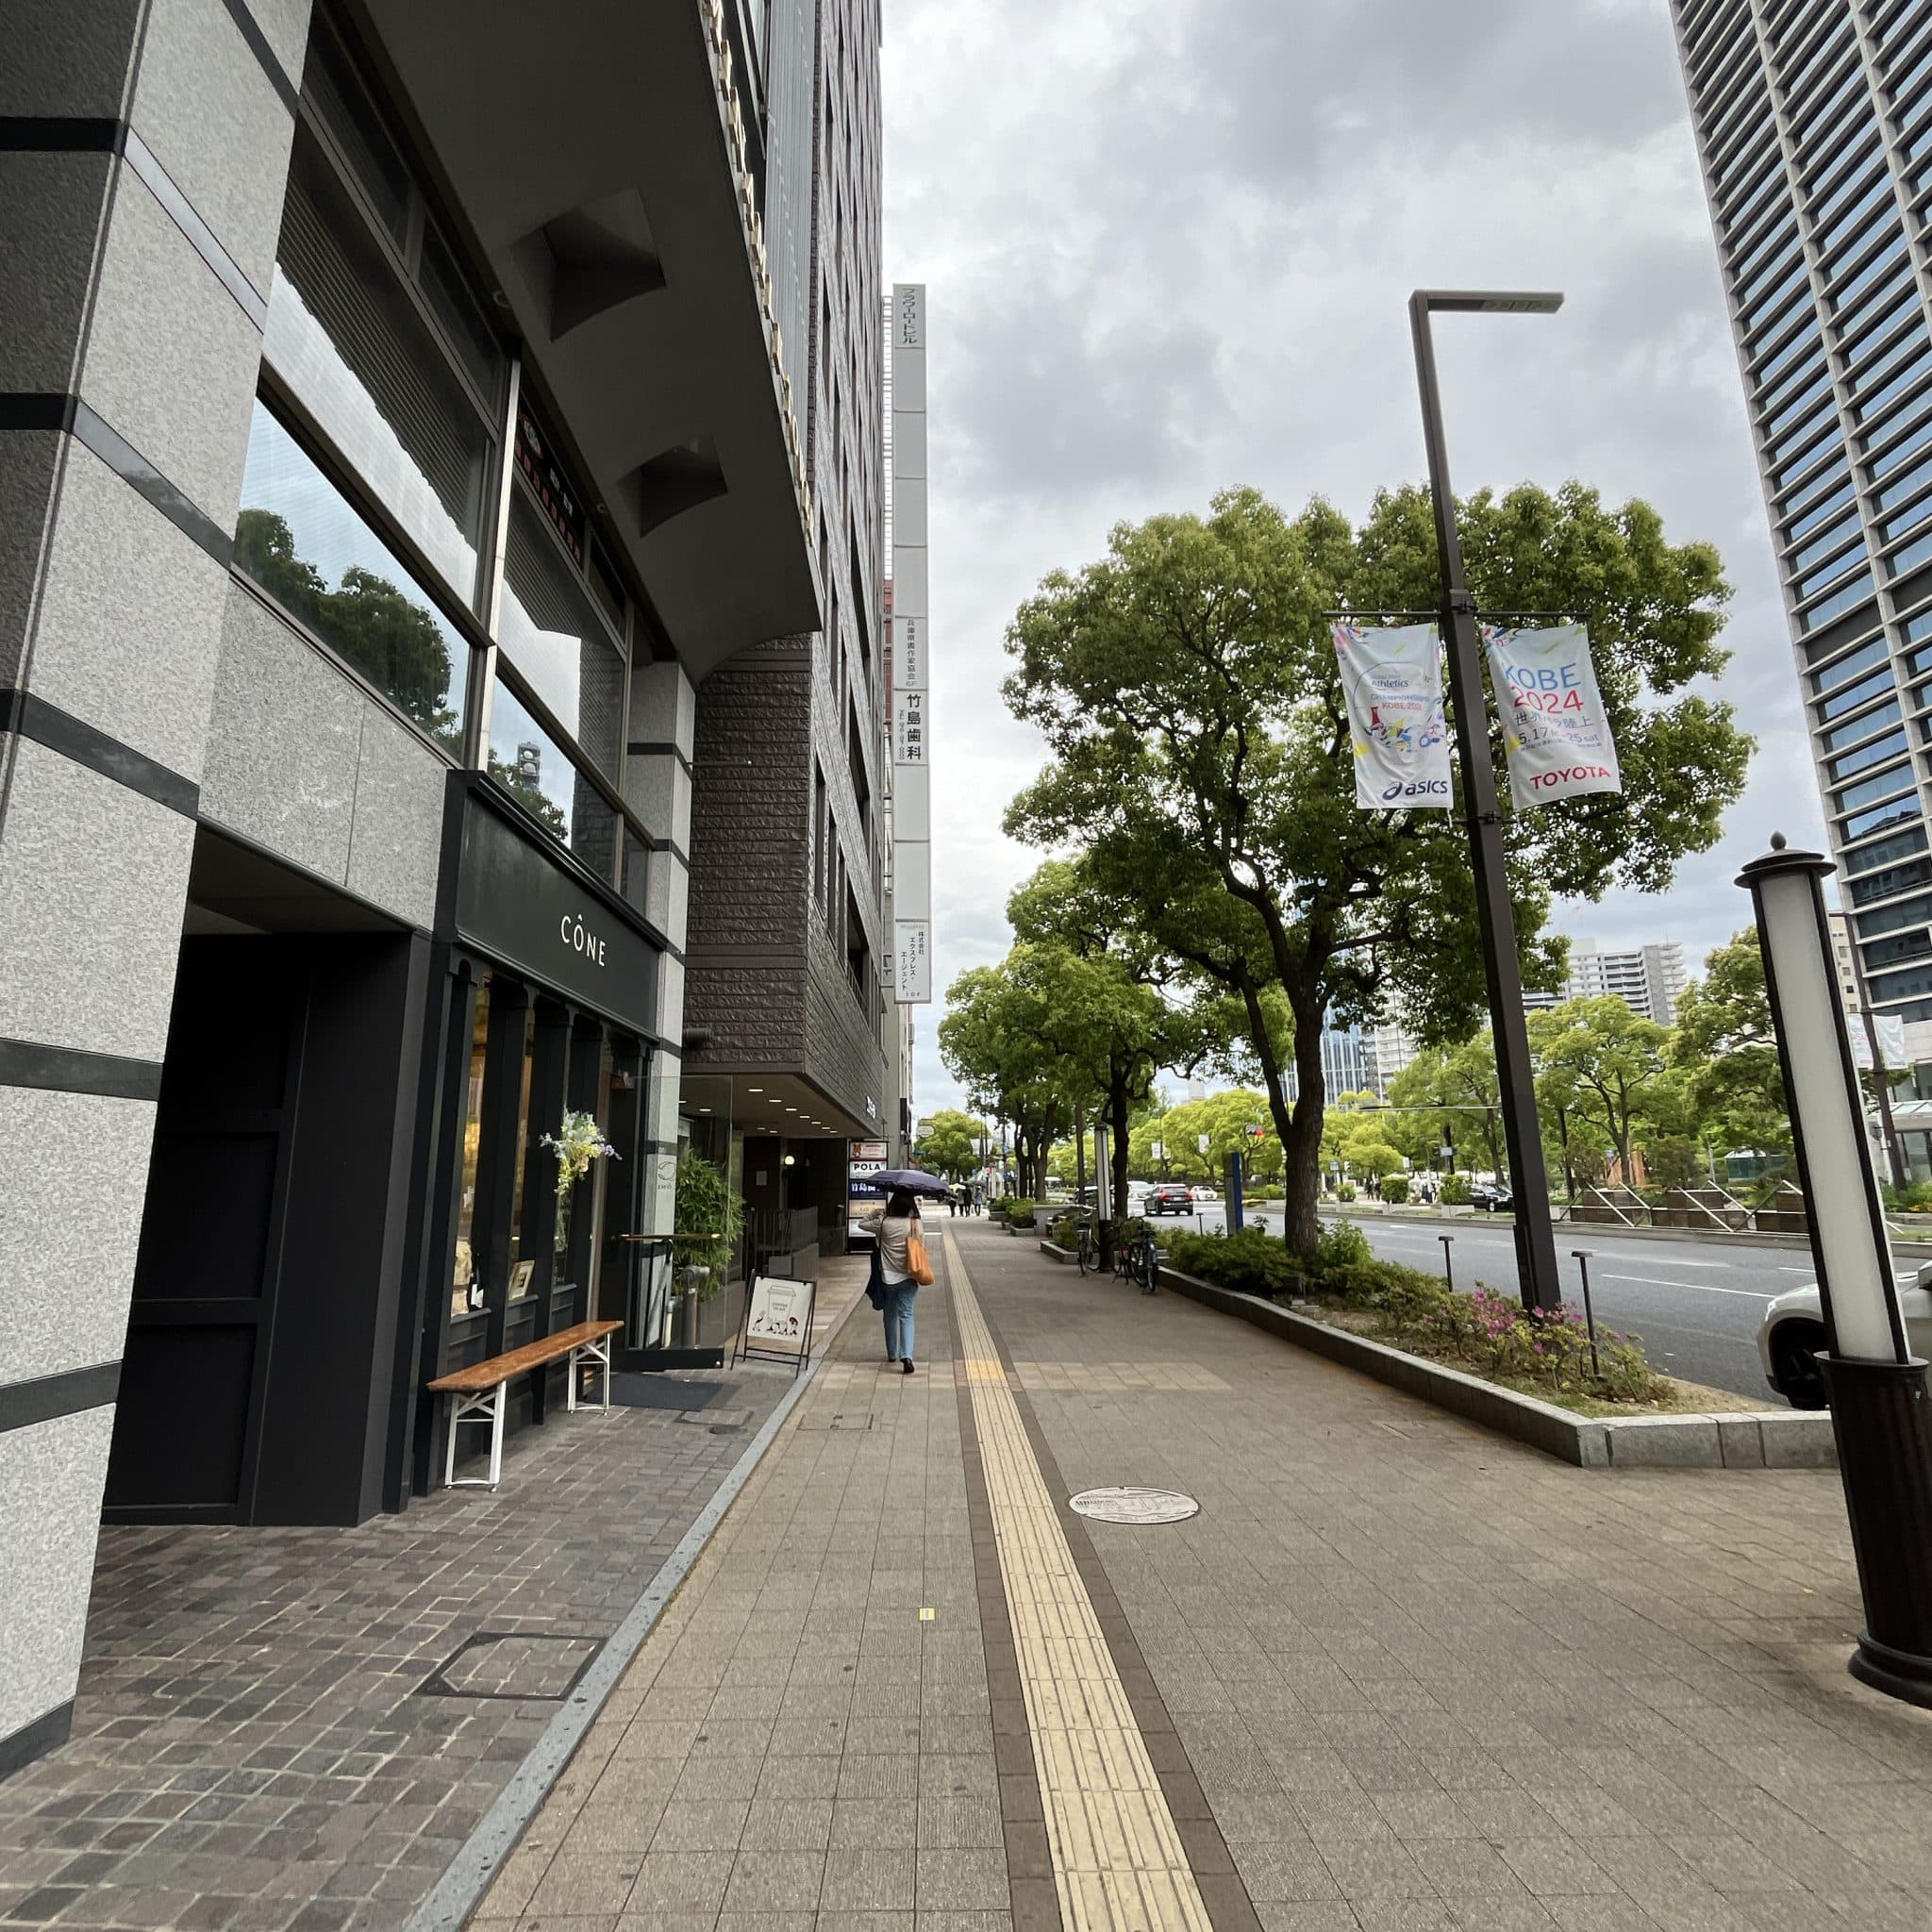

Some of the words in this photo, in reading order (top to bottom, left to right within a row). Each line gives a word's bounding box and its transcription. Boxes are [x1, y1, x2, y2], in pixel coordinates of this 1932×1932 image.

[1505, 663, 1581, 691] KOBE
[1509, 685, 1584, 714] 2024
[907, 693, 922, 760] 竹島歯科
[1529, 765, 1611, 790] TOYOTA
[560, 913, 606, 967] CÔNE
